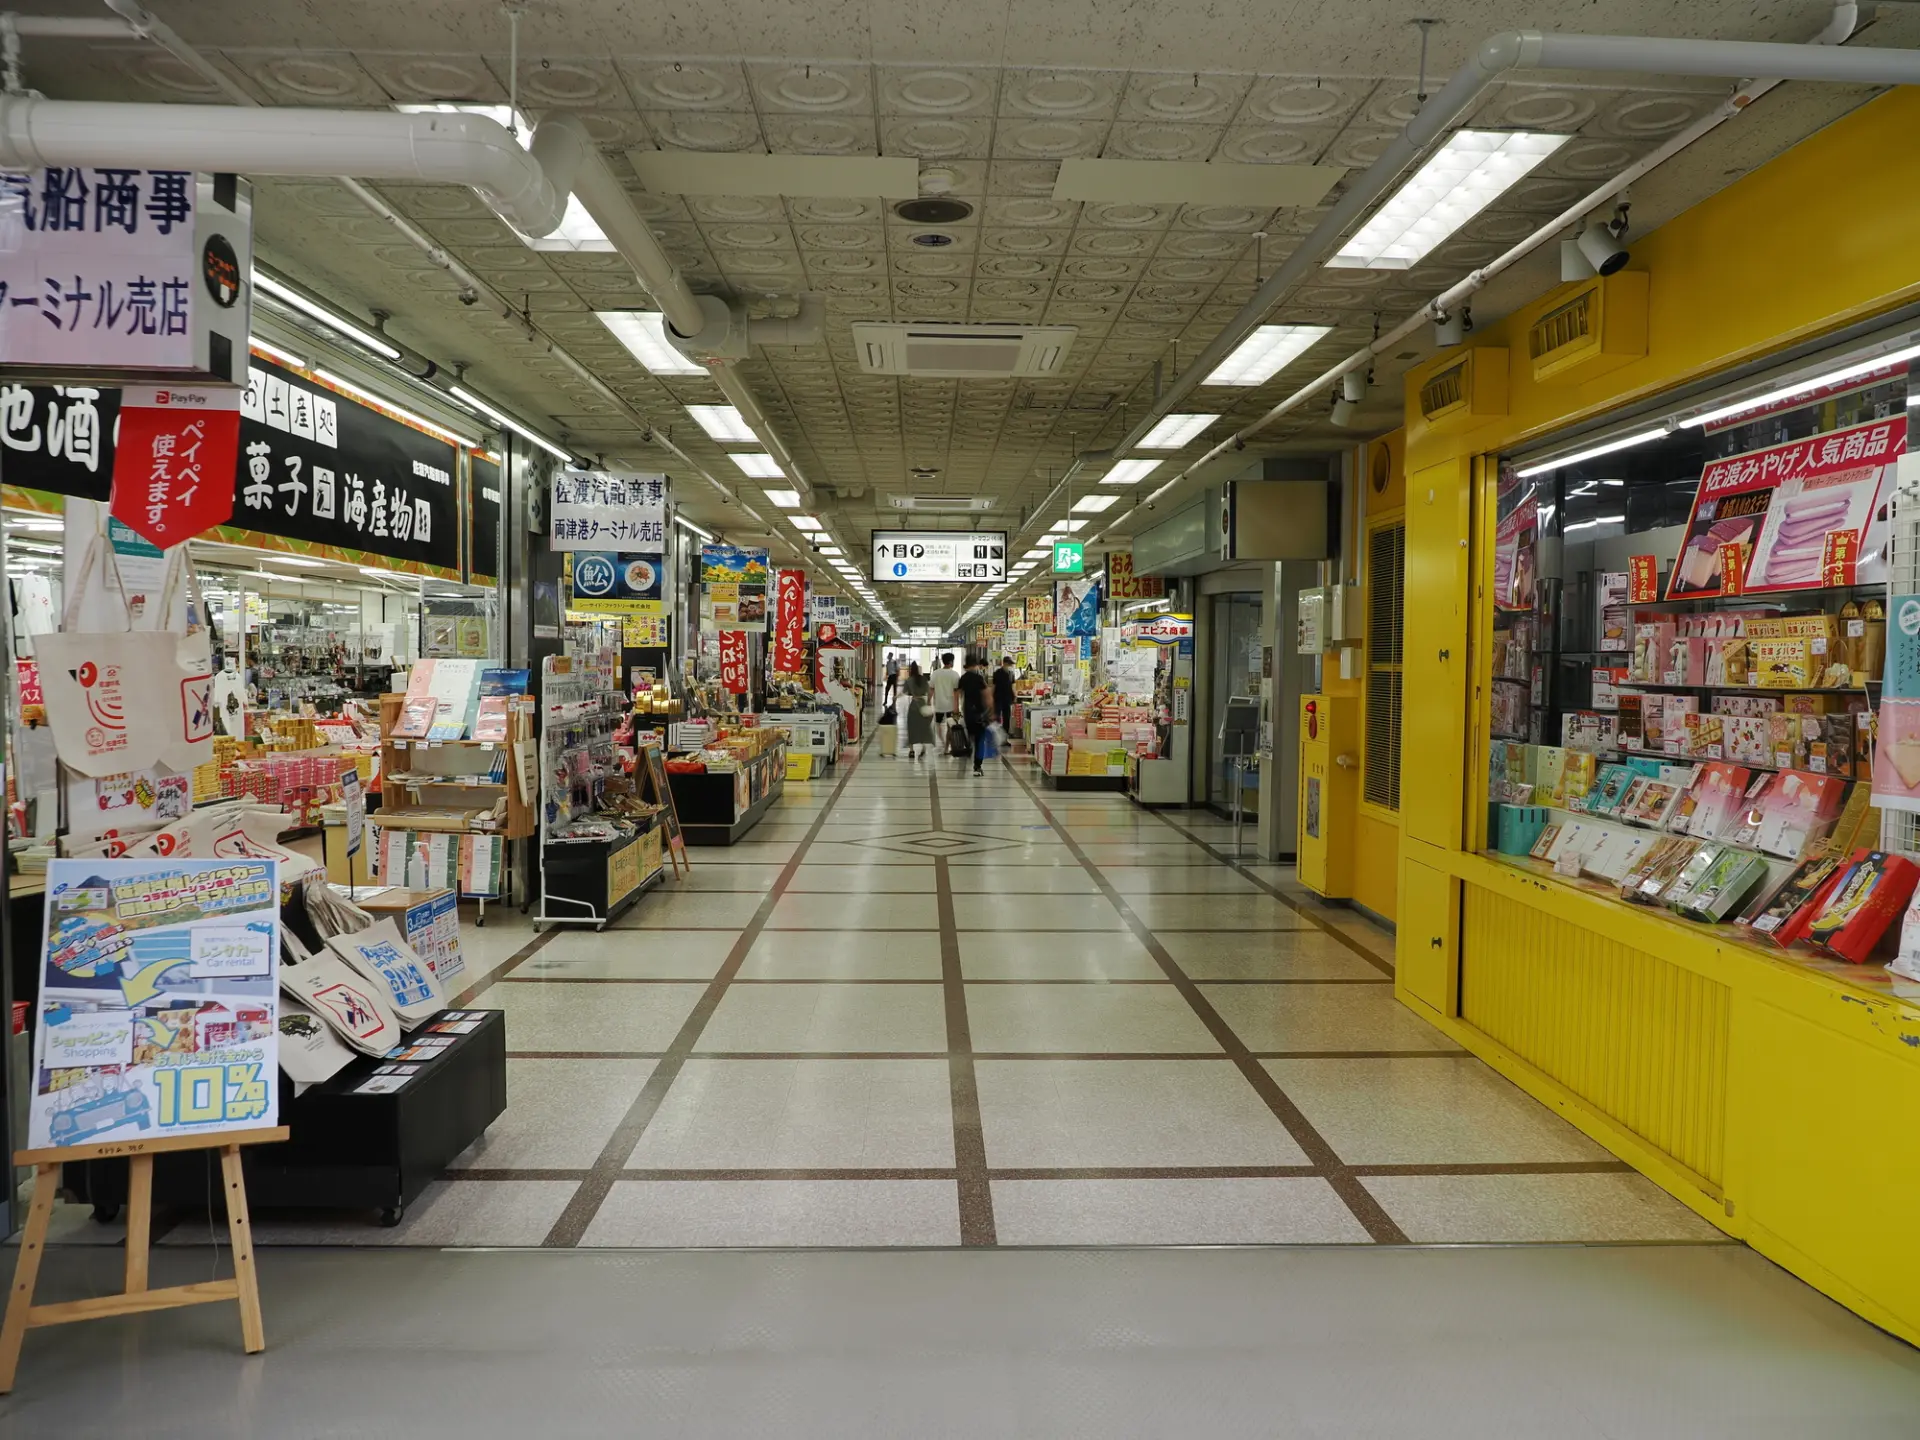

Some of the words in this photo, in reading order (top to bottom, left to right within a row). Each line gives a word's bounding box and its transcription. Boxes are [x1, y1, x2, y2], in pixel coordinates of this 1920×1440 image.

[170, 393, 207, 405] PayPay
[176, 419, 205, 507] ペイペイ
[1705, 424, 1890, 492] 佐渡みやげ人気商品
[145, 434, 177, 533] 使えます。
[243, 441, 308, 517] 菓子
[344, 473, 413, 542] 海産物
[555, 478, 663, 506] 佐渡汽船商事
[554, 518, 663, 542] 両津港ターミナル売店
[1727, 558, 1736, 594] 第1位
[1832, 546, 1847, 585] 第3位
[1111, 577, 1163, 597] エビス商事
[1639, 568, 1649, 600] 第2位
[1140, 626, 1188, 635] エビス商事
[143, 877, 234, 903] コラボレーション企画
[63, 1046, 117, 1059] Shopping
